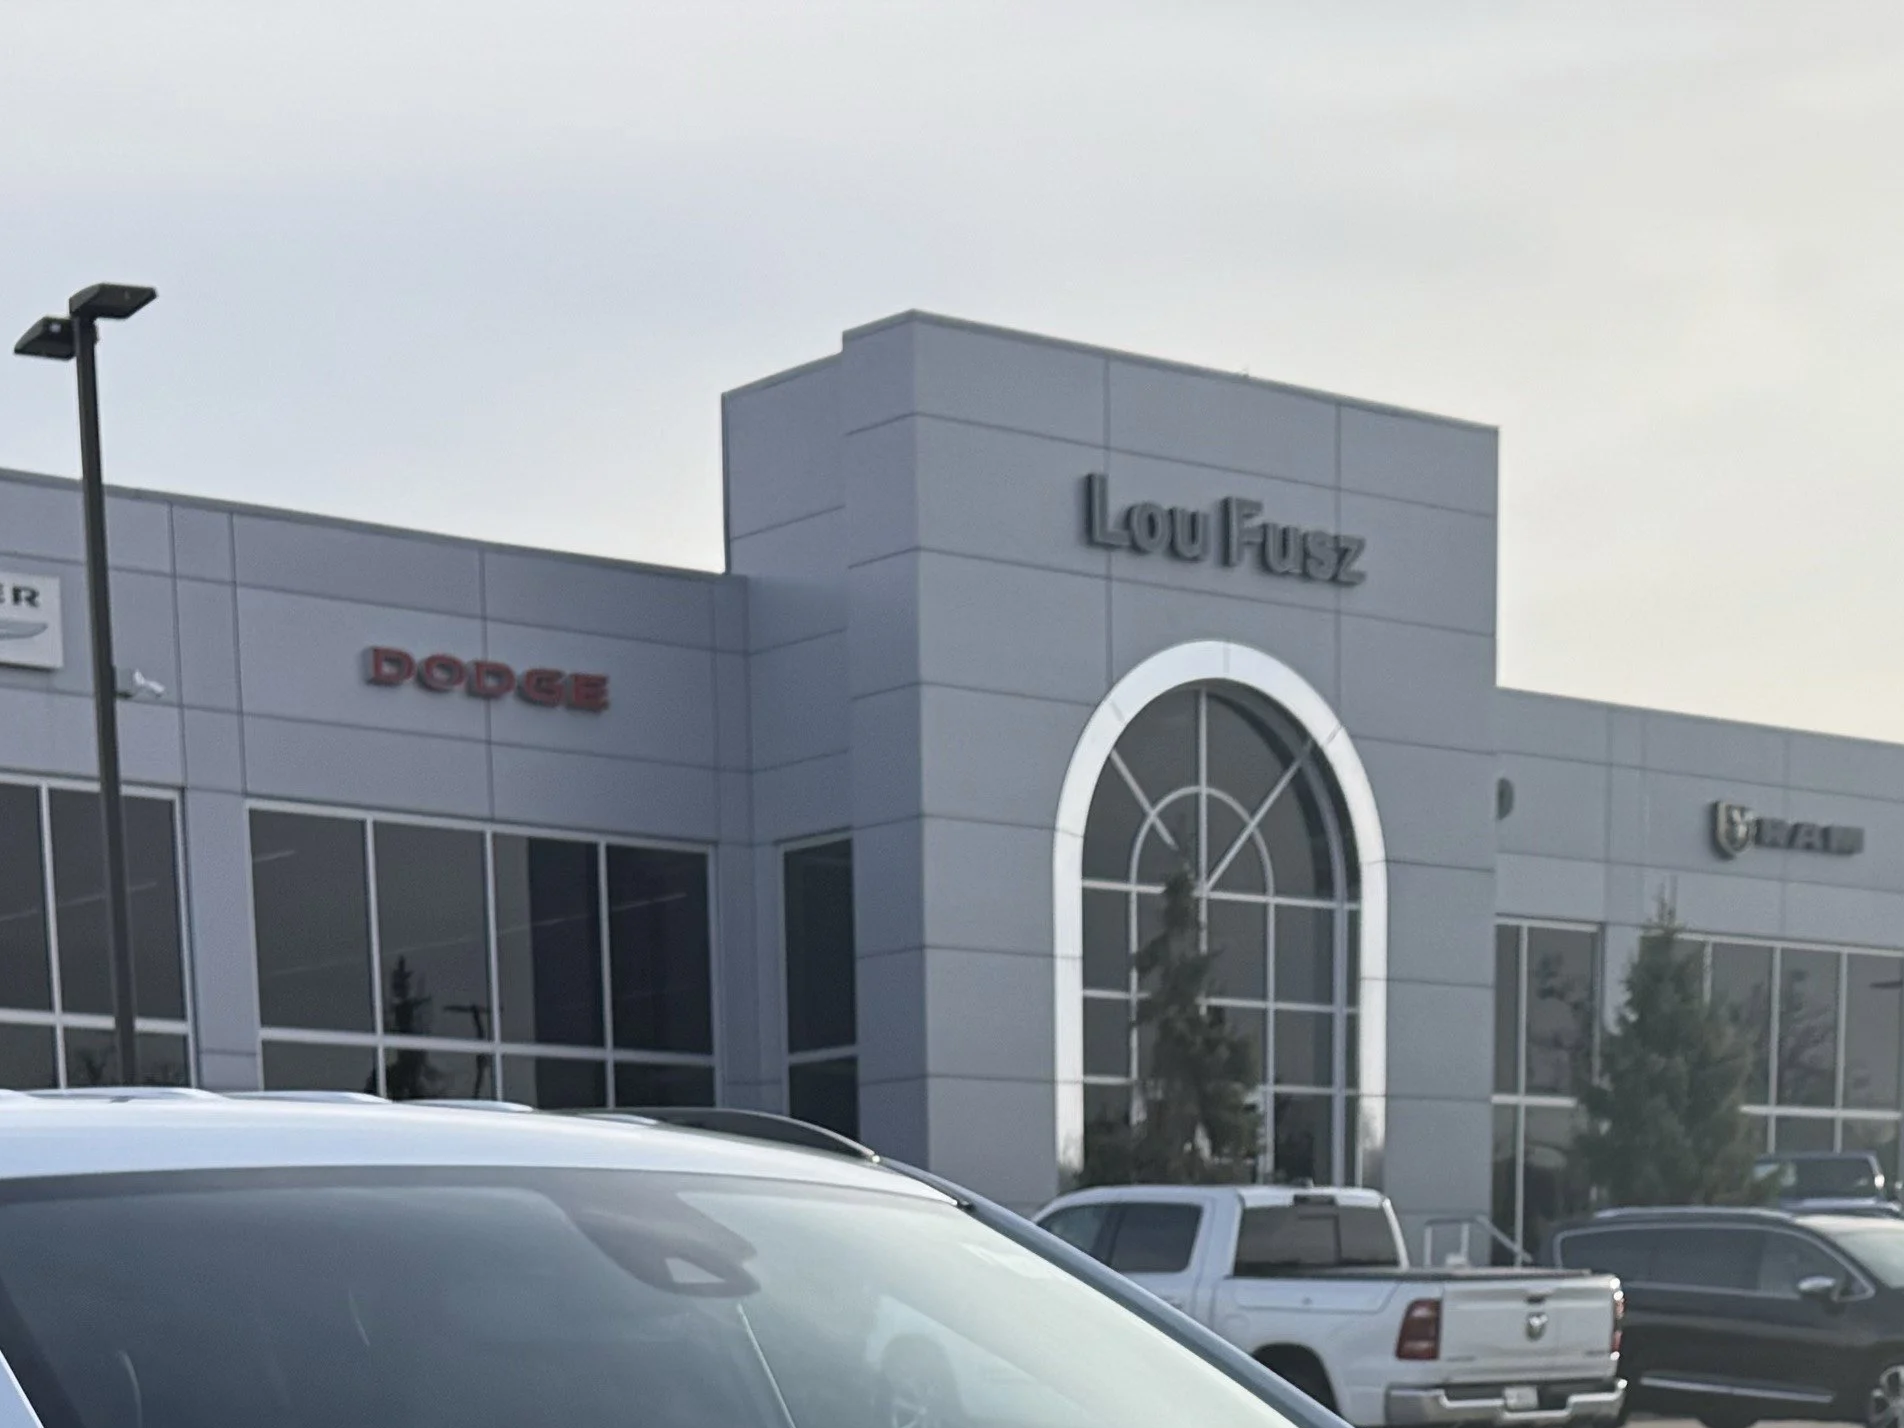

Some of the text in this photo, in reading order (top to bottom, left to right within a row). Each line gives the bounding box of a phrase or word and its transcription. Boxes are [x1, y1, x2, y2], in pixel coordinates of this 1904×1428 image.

[1080, 472, 1368, 586] Lou Fusz
[363, 645, 610, 715] DODGE
[1754, 818, 1865, 856] RAM
